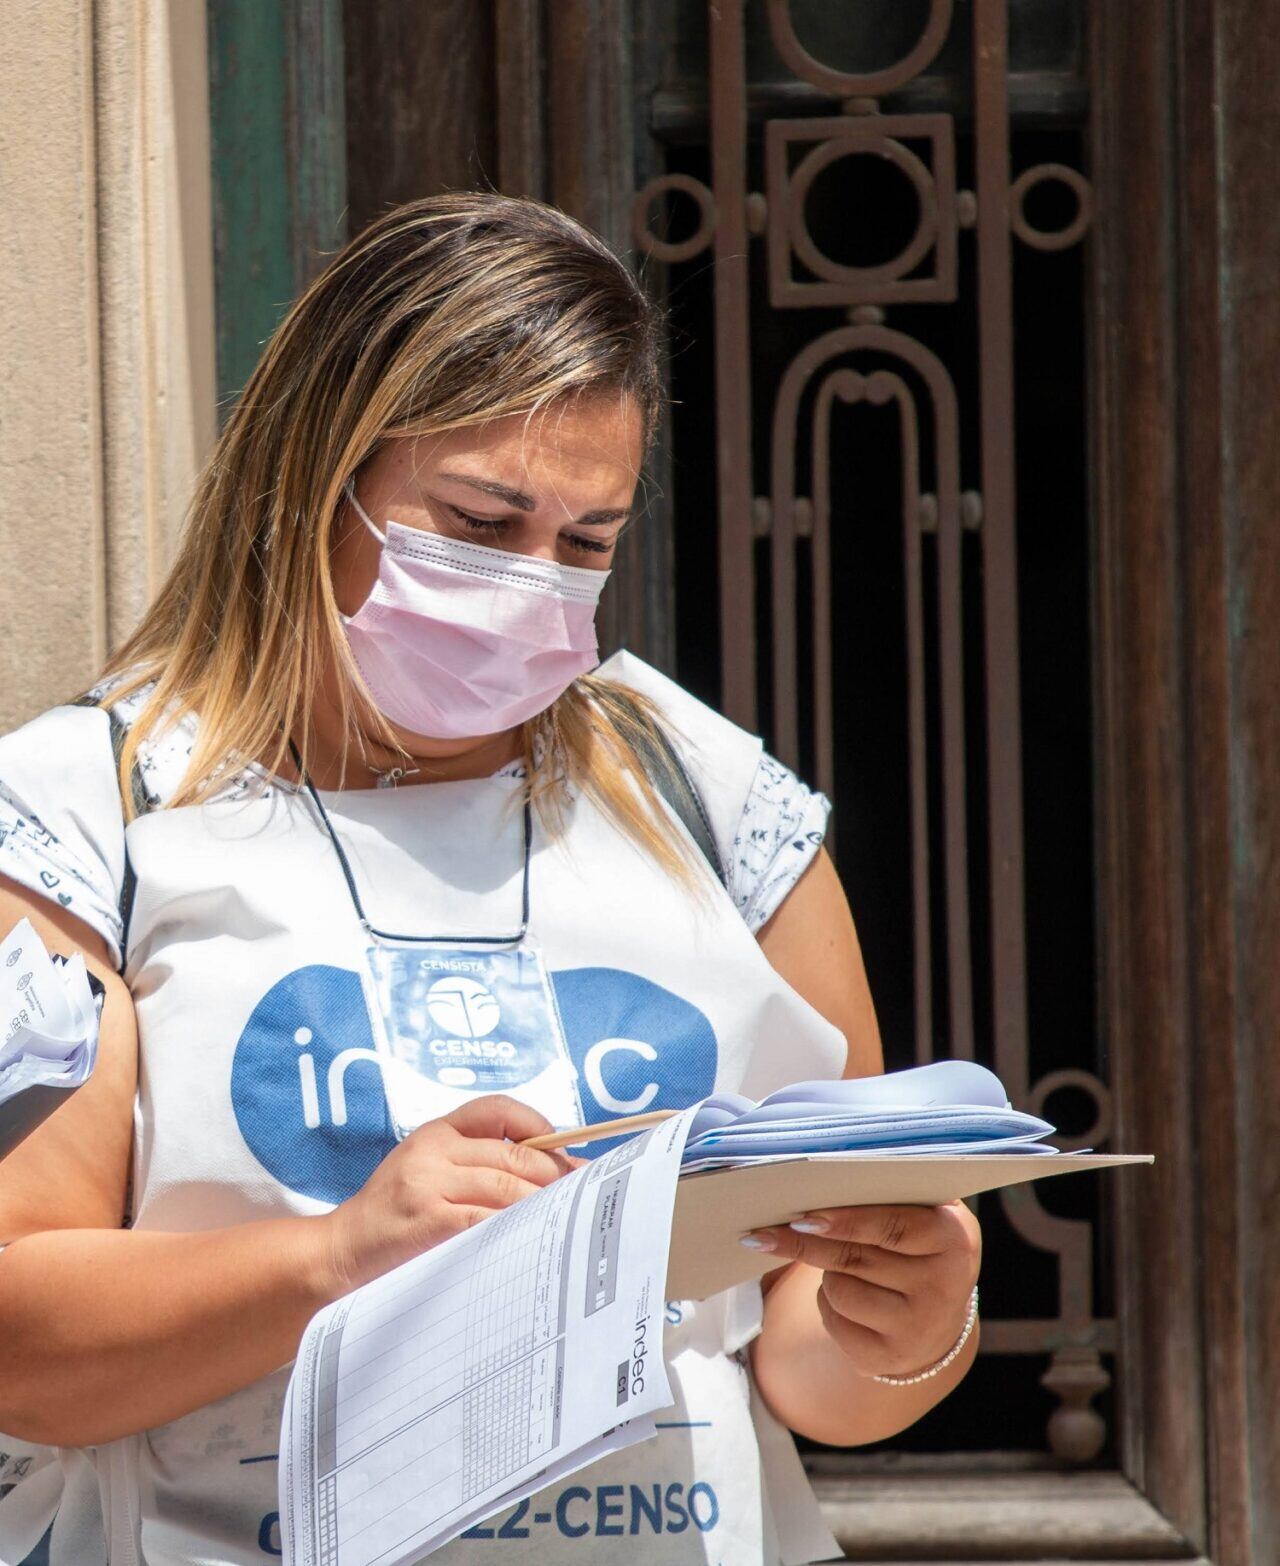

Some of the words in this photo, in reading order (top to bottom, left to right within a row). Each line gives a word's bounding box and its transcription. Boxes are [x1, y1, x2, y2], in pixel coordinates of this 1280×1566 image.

[420, 959, 487, 972] CENSISTA
[429, 1039, 517, 1057] CENSO
[294, 1027, 659, 1128] inc
[632, 1315, 651, 1396] indec
[618, 1376, 627, 1395] C1
